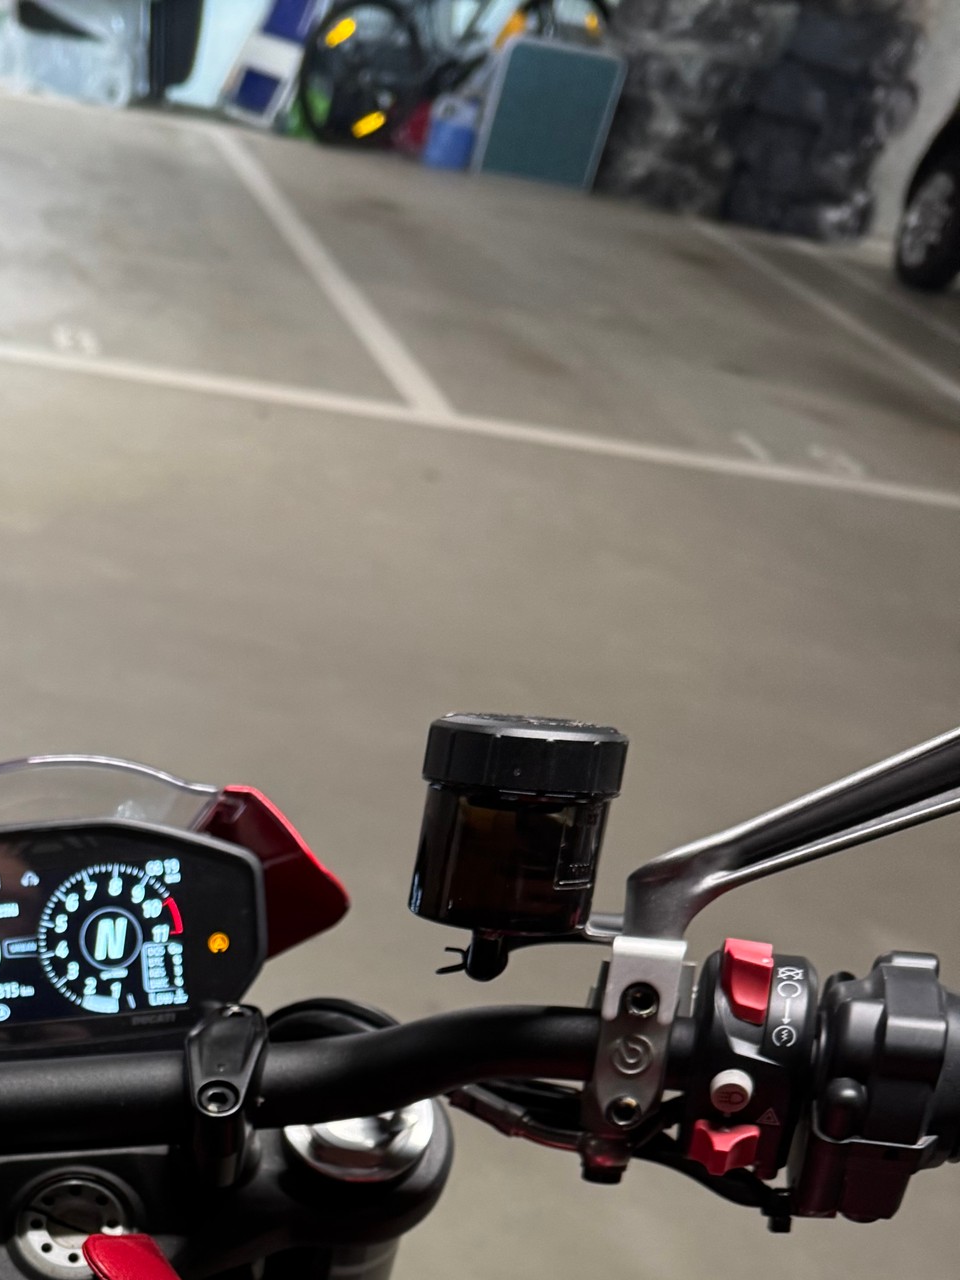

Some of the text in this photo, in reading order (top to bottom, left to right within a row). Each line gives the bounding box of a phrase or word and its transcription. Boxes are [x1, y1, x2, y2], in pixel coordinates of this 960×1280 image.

[84, 881, 97, 901] 7
[108, 877, 123, 896] 8
[131, 884, 145, 903] 9
[65, 892, 79, 912] 6
[142, 898, 162, 918] 10
[54, 913, 68, 933] 5
[152, 923, 170, 943] 11
[94, 916, 127, 960] N
[55, 940, 69, 958] 4
[66, 961, 79, 980] 3
[83, 976, 97, 995] 2
